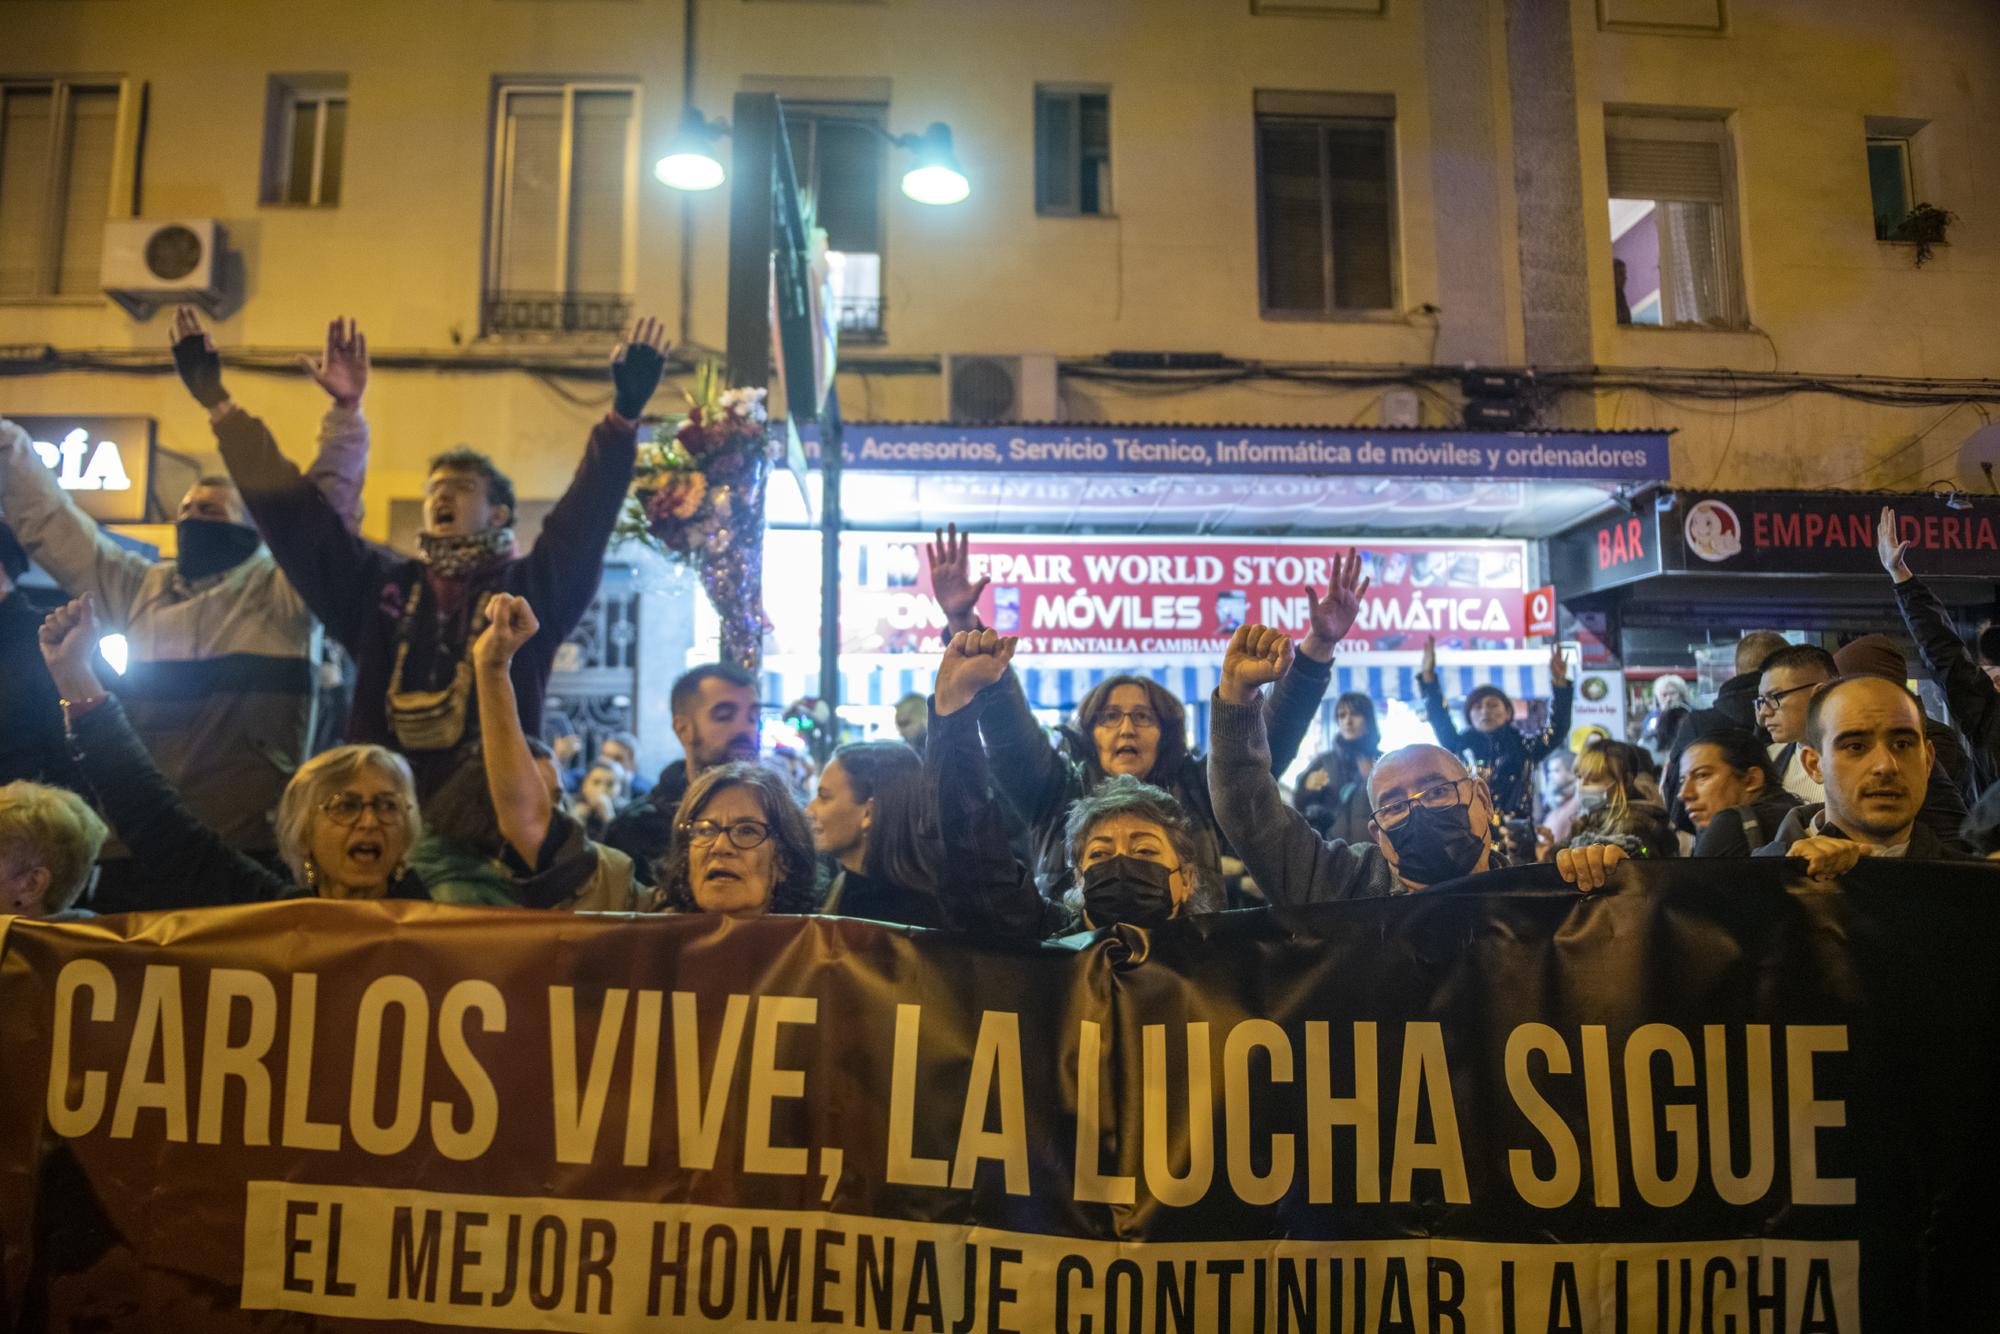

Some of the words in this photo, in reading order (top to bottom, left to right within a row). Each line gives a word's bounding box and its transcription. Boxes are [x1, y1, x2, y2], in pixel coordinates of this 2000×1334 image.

[861, 437, 1003, 464] Accesorios,
[1009, 437, 1108, 461] Servicio
[1112, 438, 1212, 466] Técnico,
[1217, 440, 1352, 464] Informática
[1357, 441, 1386, 464] de
[1391, 441, 1481, 466] móviles
[1487, 446, 1501, 471] y
[1506, 443, 1648, 468] ordenadores
[1598, 517, 1645, 570] BAR
[1753, 512, 1998, 550] EMPANDERIA
[967, 554, 1076, 585] EPAIR
[1083, 555, 1224, 586] WORLD
[1032, 588, 1202, 630] MÓVILES
[1260, 590, 1511, 632] INFRMÁTICA
[1035, 637, 1049, 653] Y
[1052, 637, 1139, 653] PANTALLA
[1141, 638, 1230, 653] CAMBIAM
[46, 958, 507, 1161] CARLOS
[549, 985, 843, 1202] VIVE,
[886, 1003, 1031, 1196] LA
[1073, 1019, 1471, 1207] LUCHA
[1504, 1023, 1857, 1209] SIGUE
[283, 1200, 356, 1298] EL
[387, 1206, 617, 1316] MEJOR
[646, 1217, 1023, 1334] HOMENAJE
[1055, 1254, 1467, 1334] CONTINUAR
[1615, 1256, 1840, 1334] LUCHA
